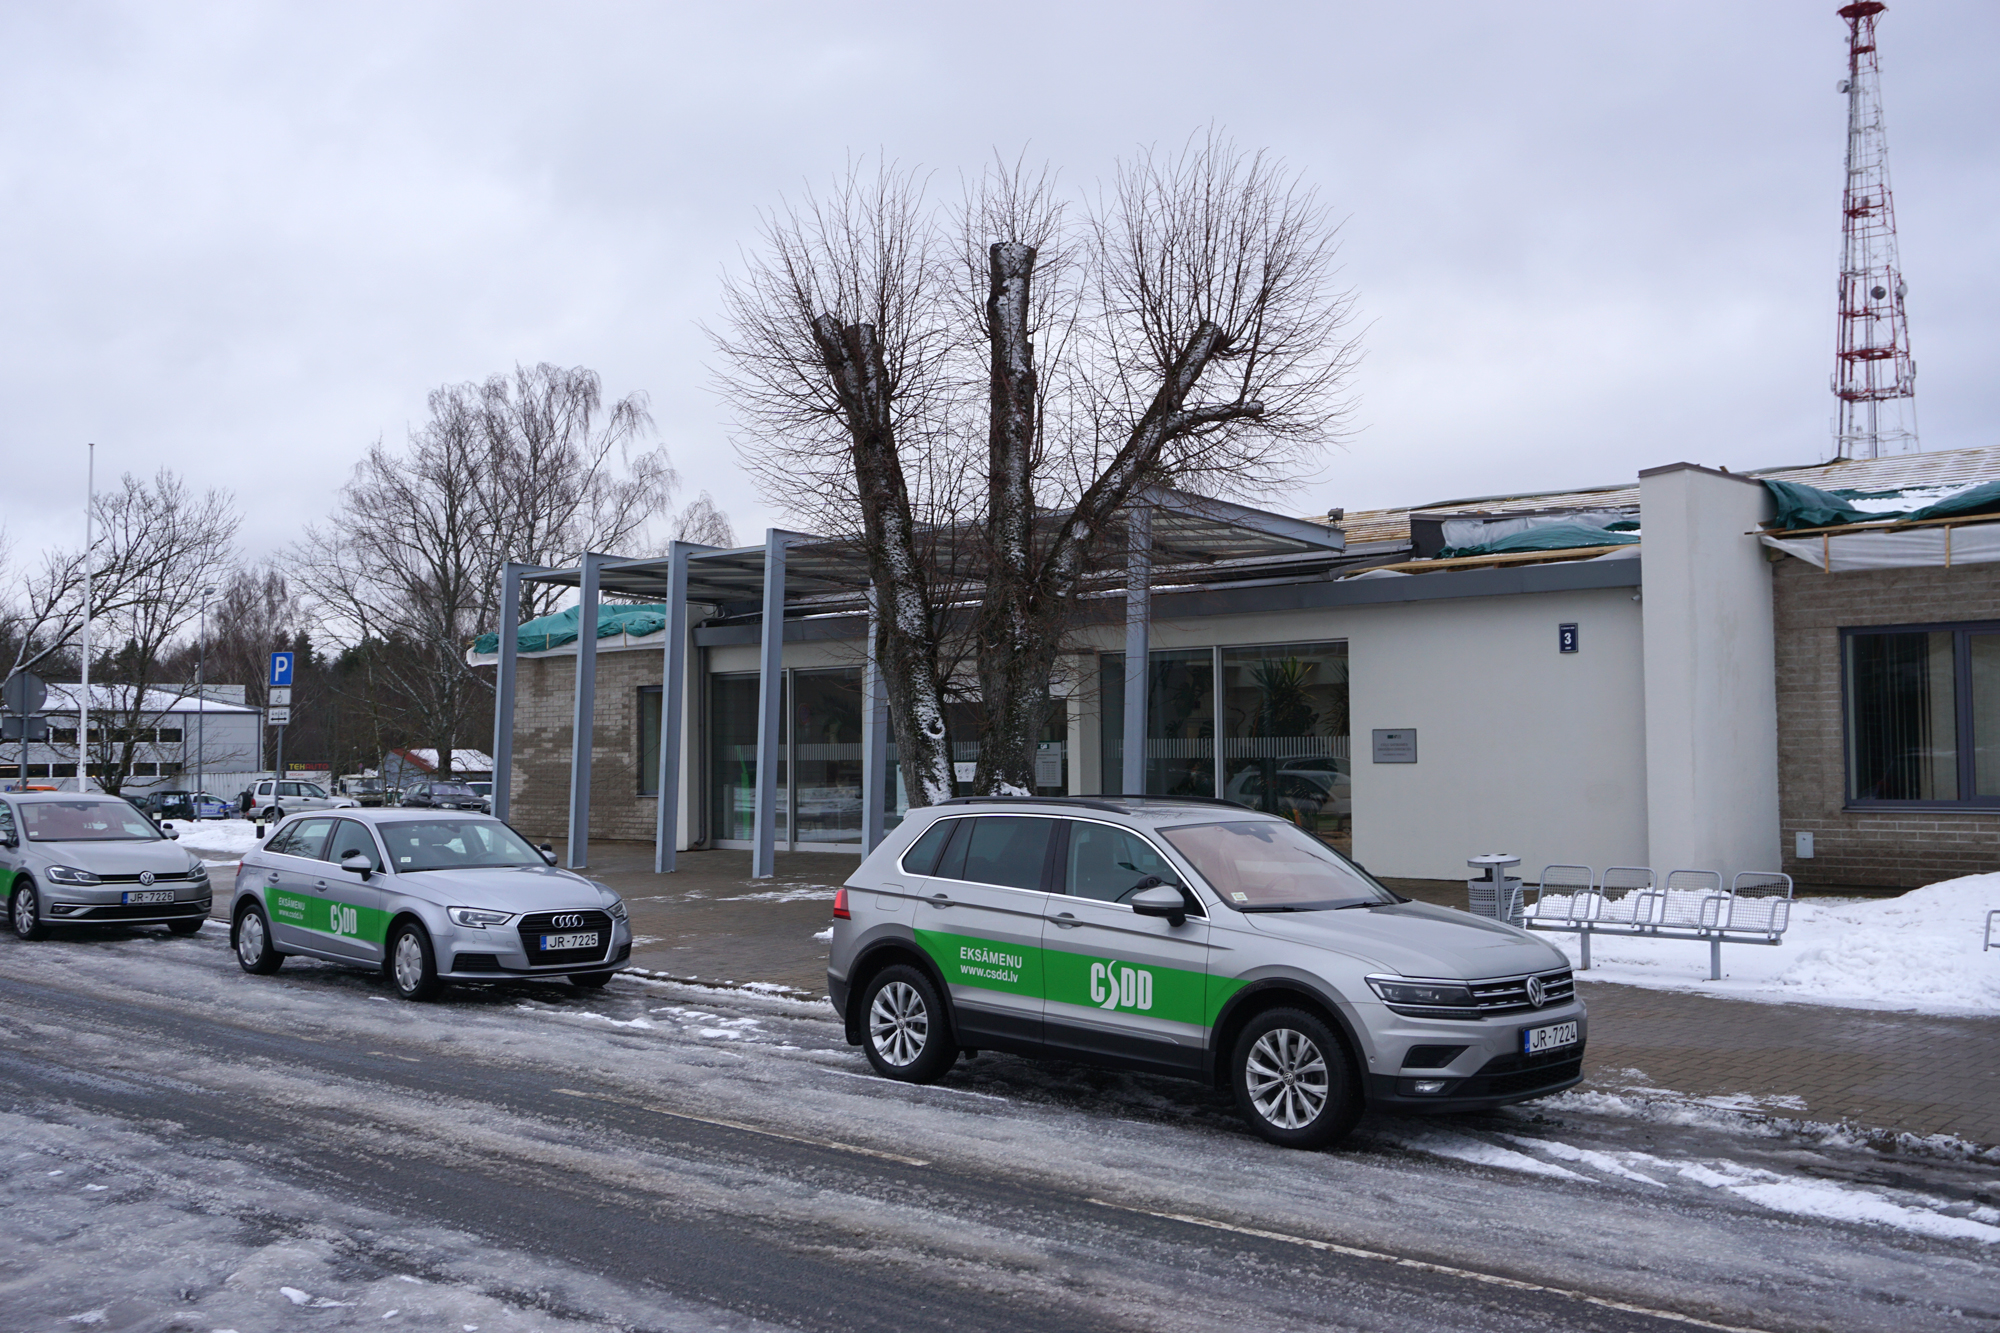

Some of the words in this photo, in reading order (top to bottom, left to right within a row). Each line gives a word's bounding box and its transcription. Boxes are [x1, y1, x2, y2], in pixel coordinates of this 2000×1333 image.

[1564, 632, 1572, 645] 3
[274, 656, 288, 682] P
[288, 763, 330, 771] TEHAUTO
[130, 892, 173, 902] JR-7226
[330, 902, 357, 935] CSDD
[549, 934, 597, 948] JR-7225
[960, 946, 1022, 969] EKSĀMENU
[960, 965, 1018, 983] www.csdd.lv
[1090, 960, 1153, 1011] CSDD
[1532, 1023, 1576, 1049] JR-7224
